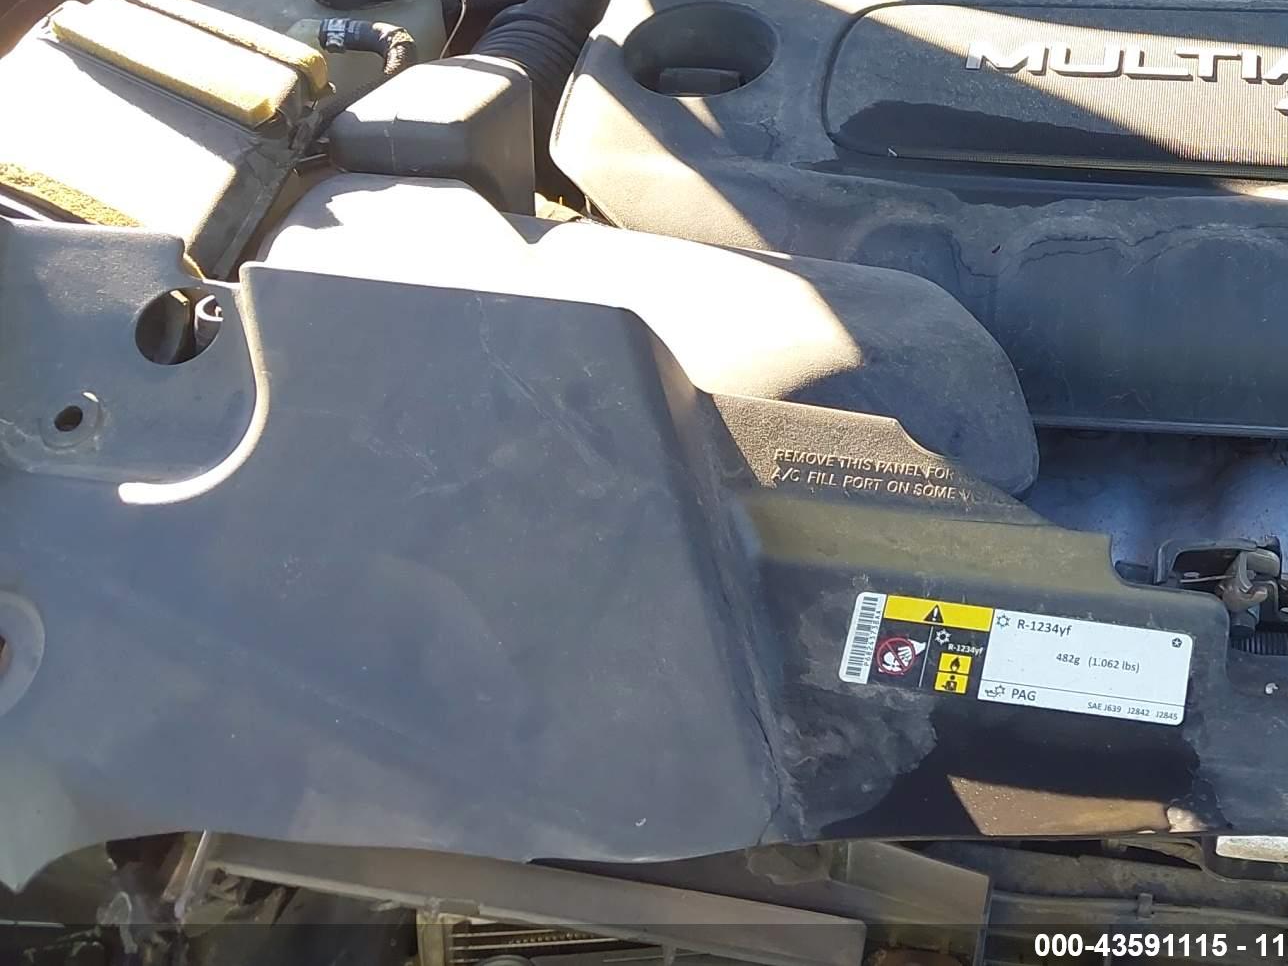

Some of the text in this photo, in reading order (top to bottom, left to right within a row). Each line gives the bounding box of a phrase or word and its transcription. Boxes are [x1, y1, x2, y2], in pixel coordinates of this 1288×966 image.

[773, 449, 954, 480] REMOVE THIS PANEL FOR
[772, 466, 800, 482] A/C
[807, 471, 837, 486] FILL
[843, 475, 883, 491] PORT
[887, 480, 909, 495] ON
[913, 483, 957, 499] SOME
[1016, 618, 1072, 637] R-1234yf
[947, 643, 984, 657] R-1234yf
[1056, 652, 1140, 674] 482g (1.062 lbs)
[1011, 687, 1037, 702] PAG
[1087, 700, 1178, 721] SAE J639 J2842 J2845
